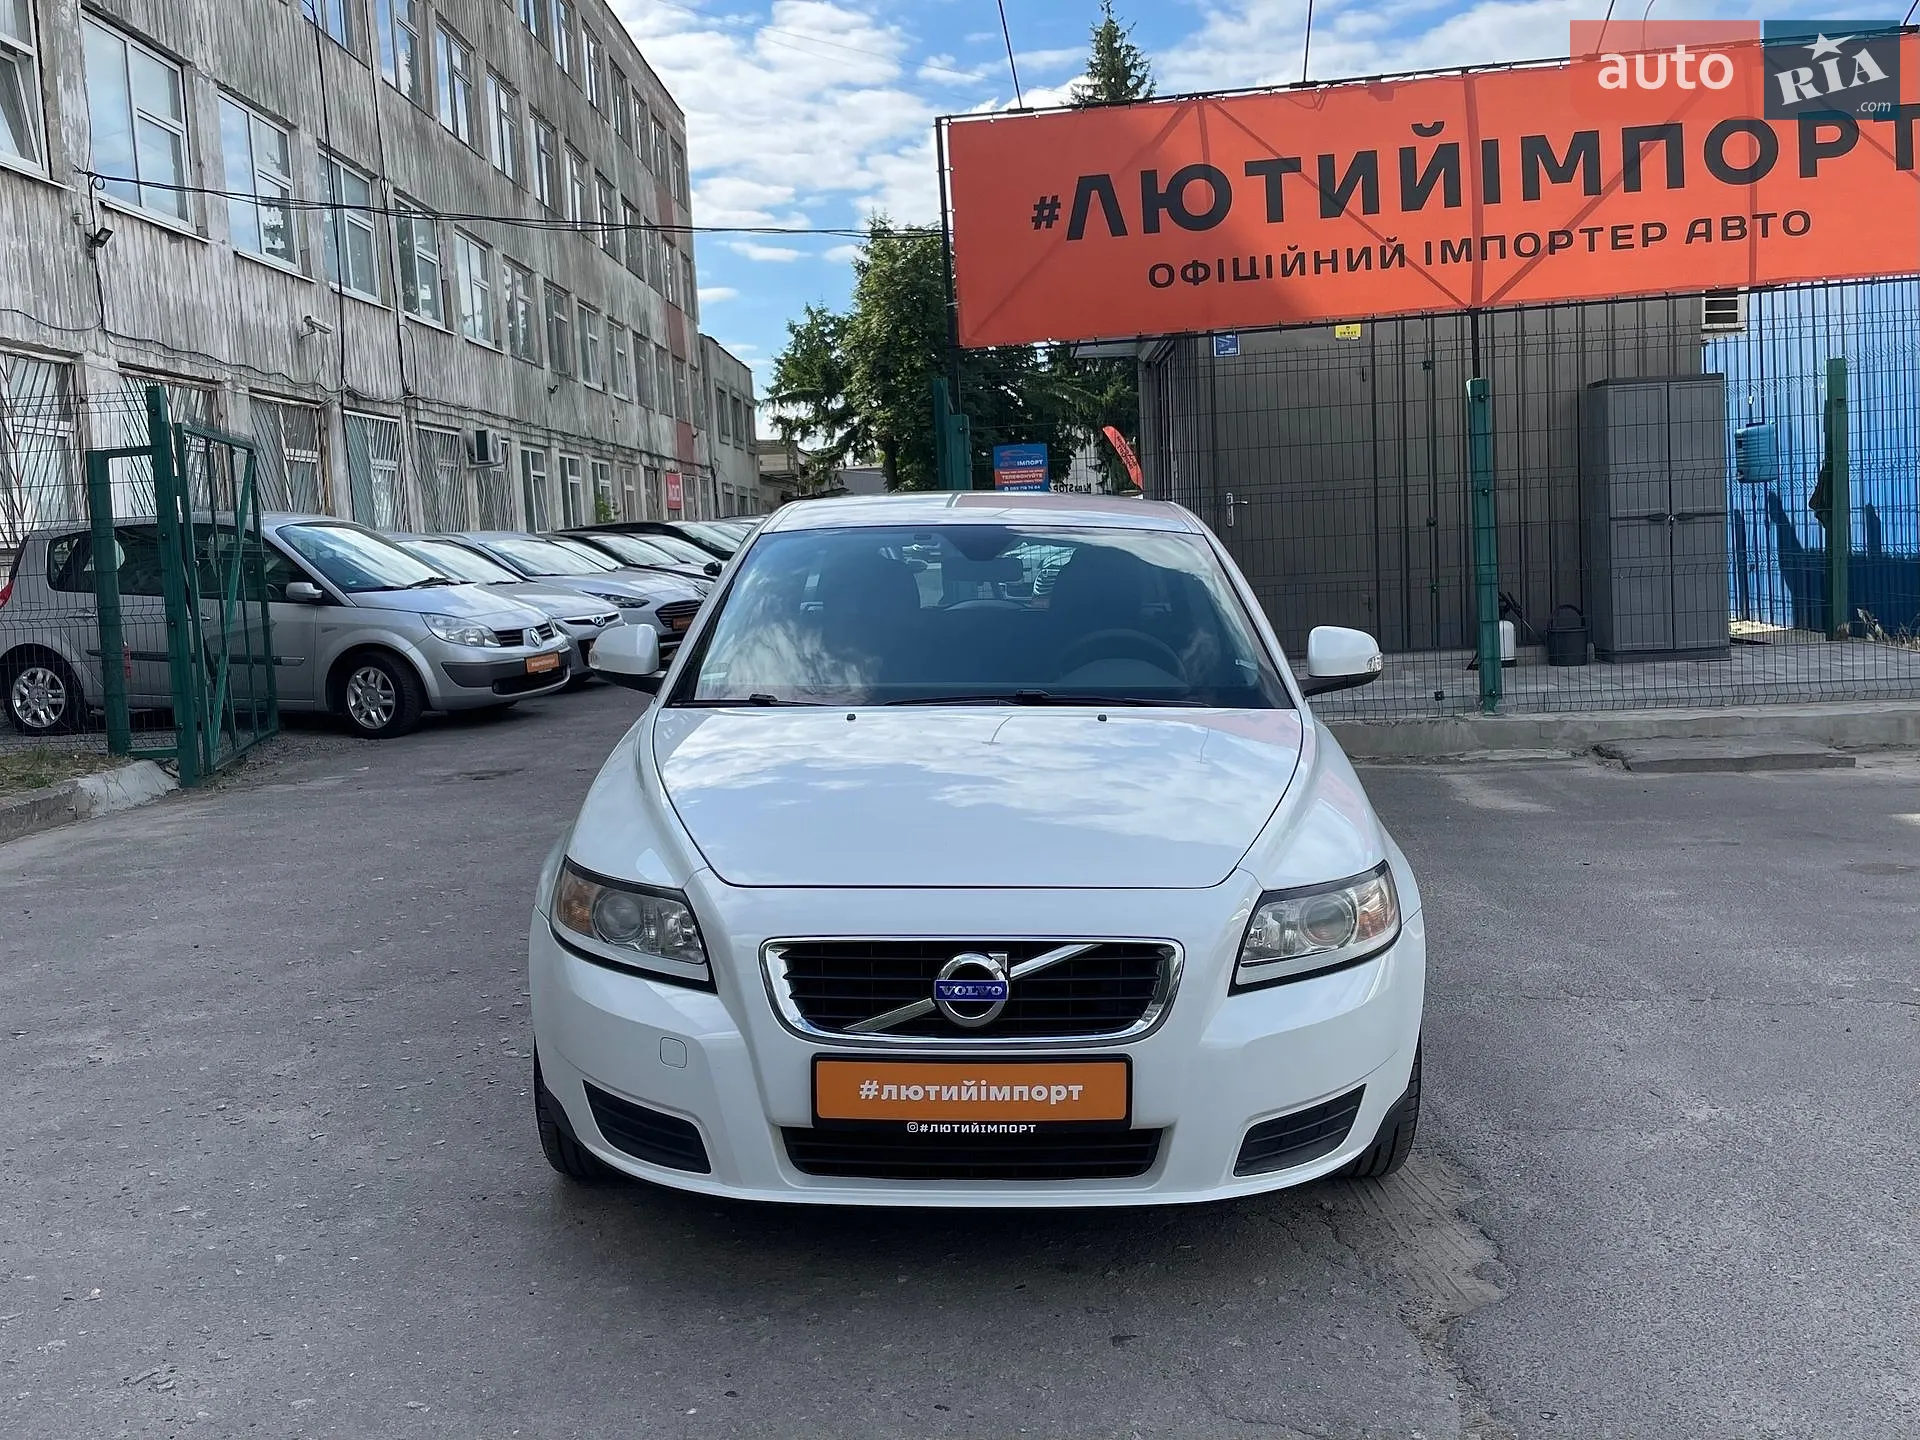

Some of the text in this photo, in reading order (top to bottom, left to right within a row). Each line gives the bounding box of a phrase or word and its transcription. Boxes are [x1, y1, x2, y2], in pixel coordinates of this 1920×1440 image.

[1030, 103, 1920, 242] #ЛЮТИЙІМПОРТ
[1148, 209, 1812, 289] ОФІЦІЙНИЙ ІМПОРТЕР АВТО
[939, 985, 1003, 996] VOLVO
[859, 1080, 1084, 1105] #лютийімпорт
[919, 1122, 1037, 1133] #ЛЮТИЙІМПОРТ
